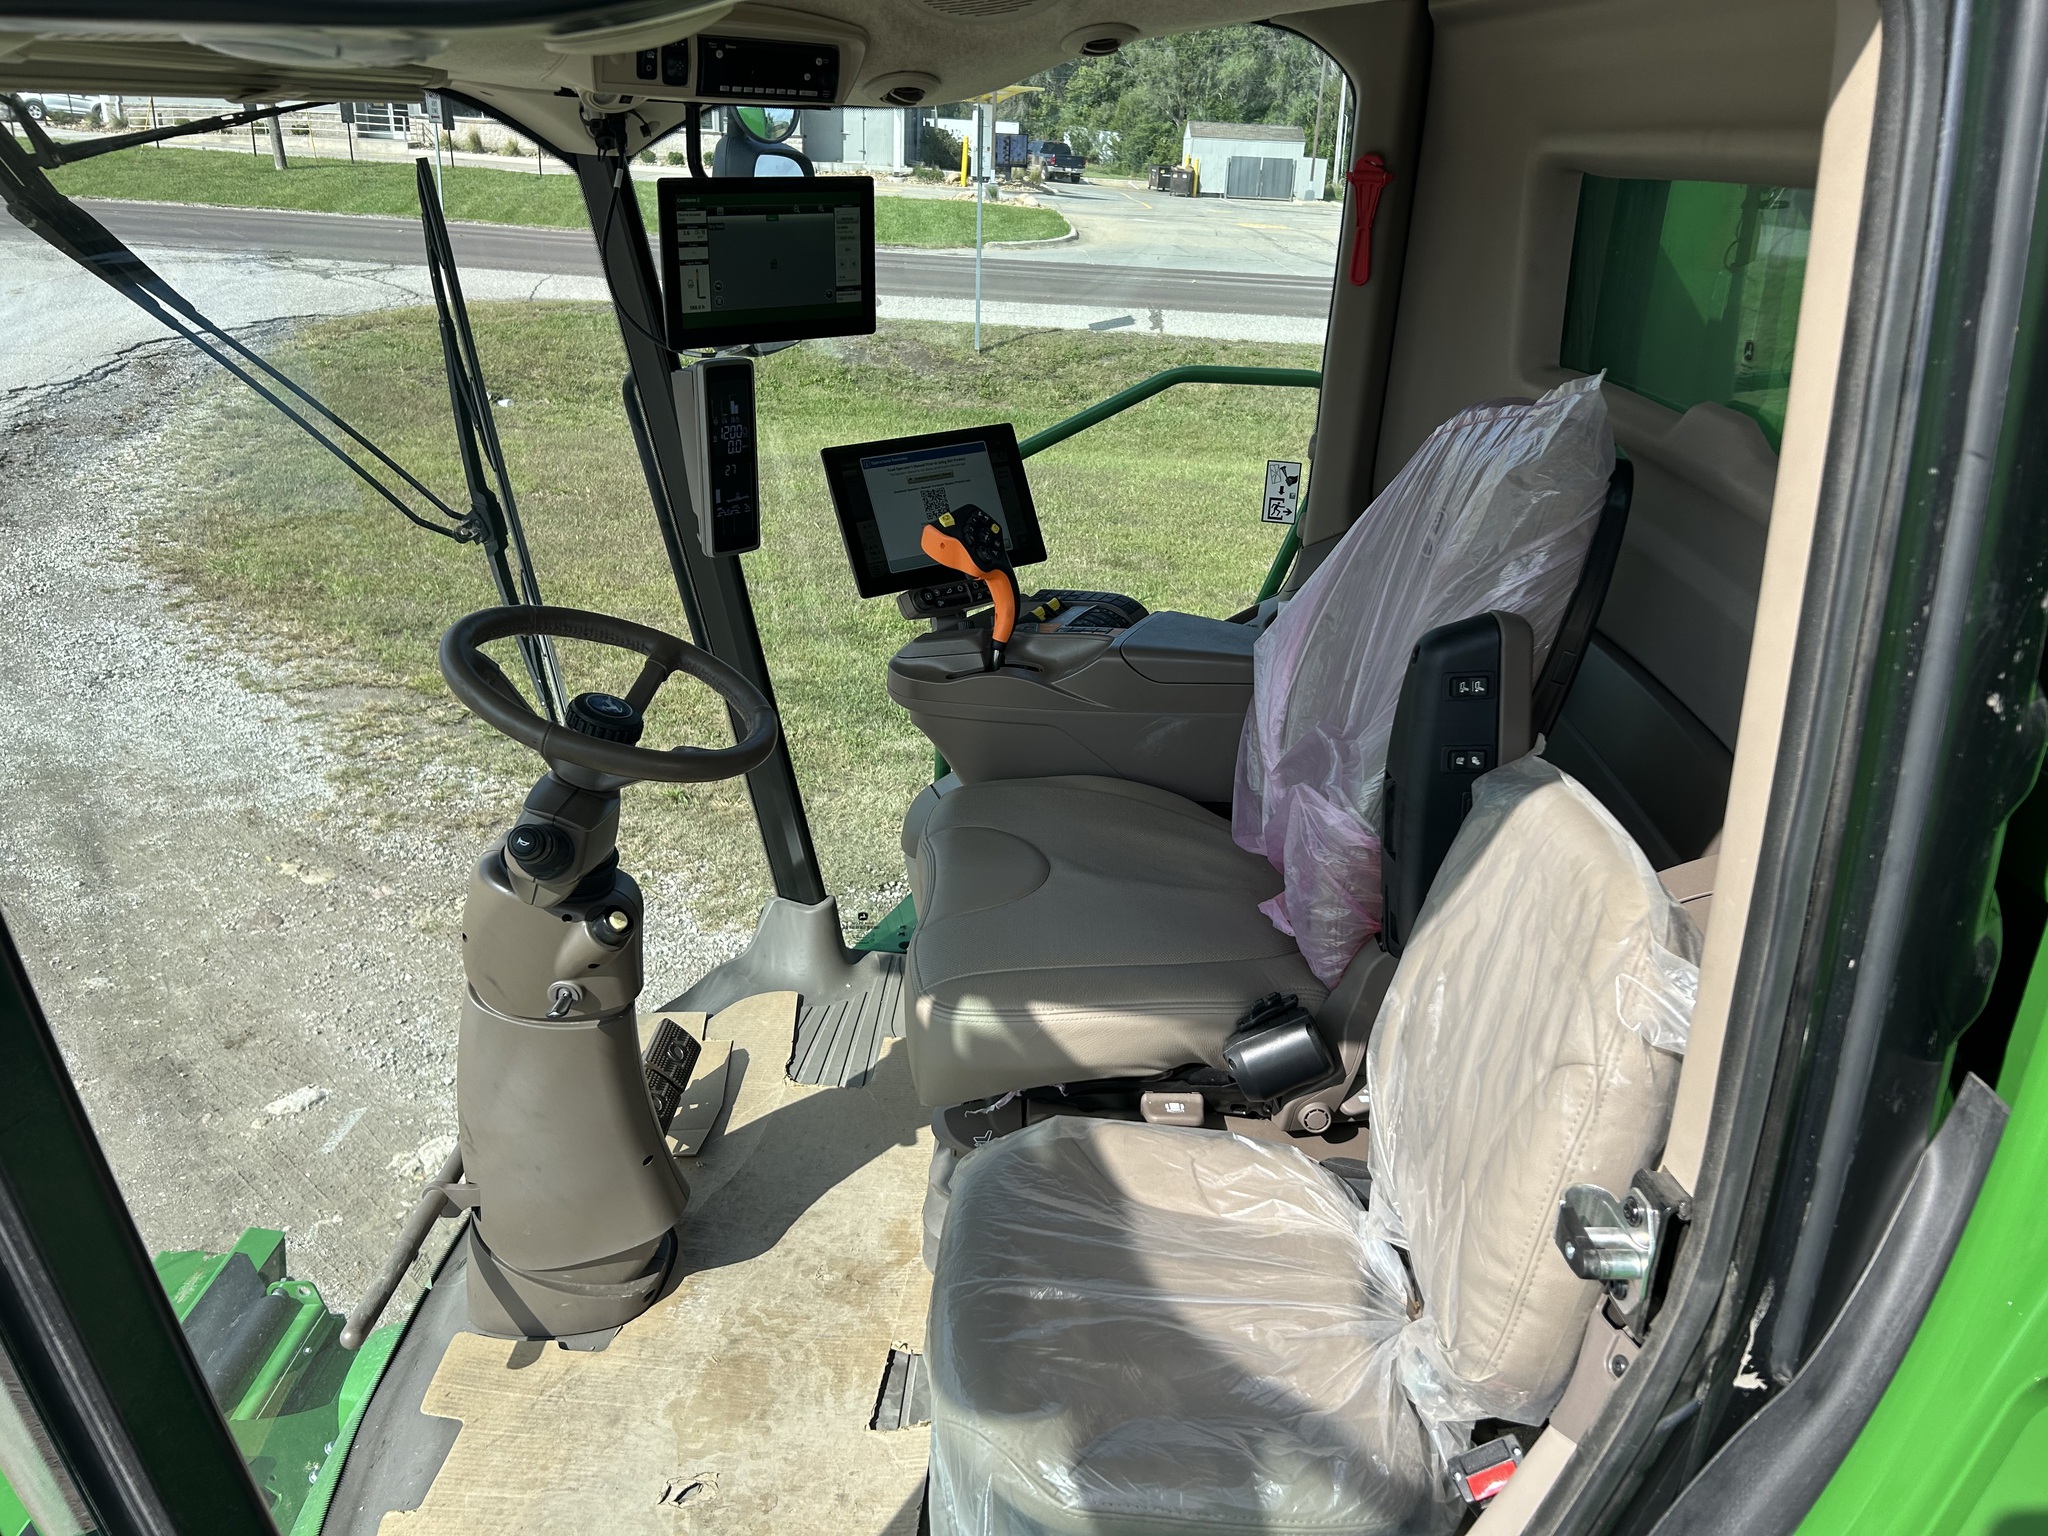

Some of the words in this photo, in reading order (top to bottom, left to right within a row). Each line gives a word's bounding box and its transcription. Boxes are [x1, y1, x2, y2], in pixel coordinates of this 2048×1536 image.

[721, 424, 743, 440] 1200
[728, 439, 742, 454] 0.0
[725, 464, 737, 476] 27
